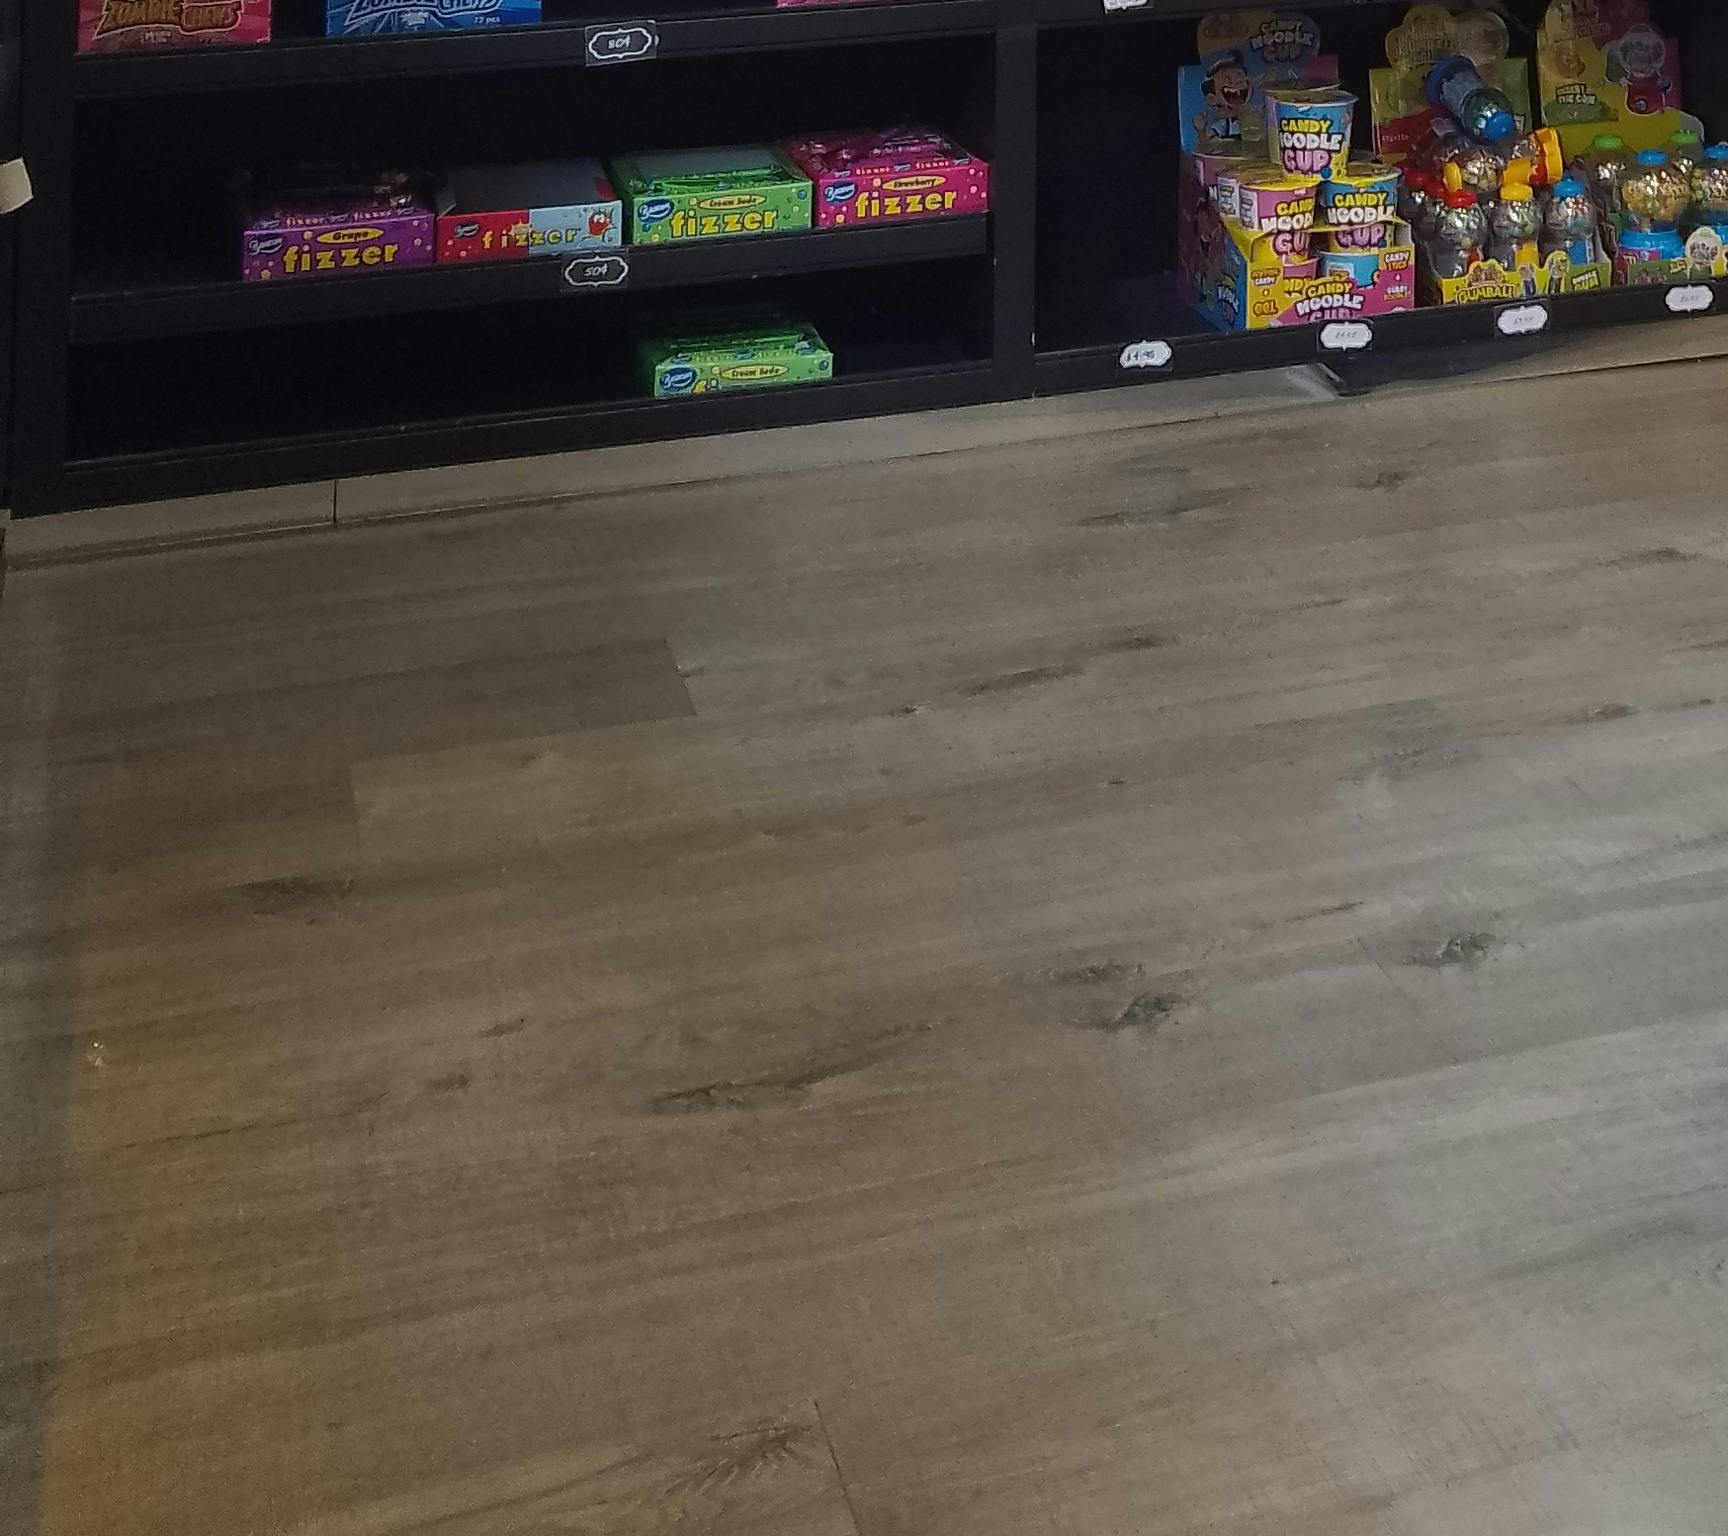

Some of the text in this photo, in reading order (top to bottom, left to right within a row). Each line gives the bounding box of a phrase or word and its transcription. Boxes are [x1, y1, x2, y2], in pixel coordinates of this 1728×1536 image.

[1281, 119, 1331, 134] CANDY
[1279, 133, 1343, 151] NOODLE
[1283, 150, 1331, 174] CUP
[893, 178, 937, 190] Strawberry
[707, 196, 735, 209] Cream
[856, 190, 958, 218] fizzer
[1333, 192, 1387, 207] CANDY
[670, 208, 778, 238] fizzer
[1327, 205, 1396, 225] NOODLE
[332, 231, 369, 243] Grape
[482, 228, 578, 250] fizzer
[1336, 226, 1385, 249] CUP
[284, 243, 398, 273] fizzer
[1384, 251, 1411, 264] CANDY
[1307, 281, 1353, 299] CANDY
[1457, 284, 1515, 306] GUMBALL
[1296, 294, 1364, 316] NOODLE
[730, 368, 757, 379] Cream
